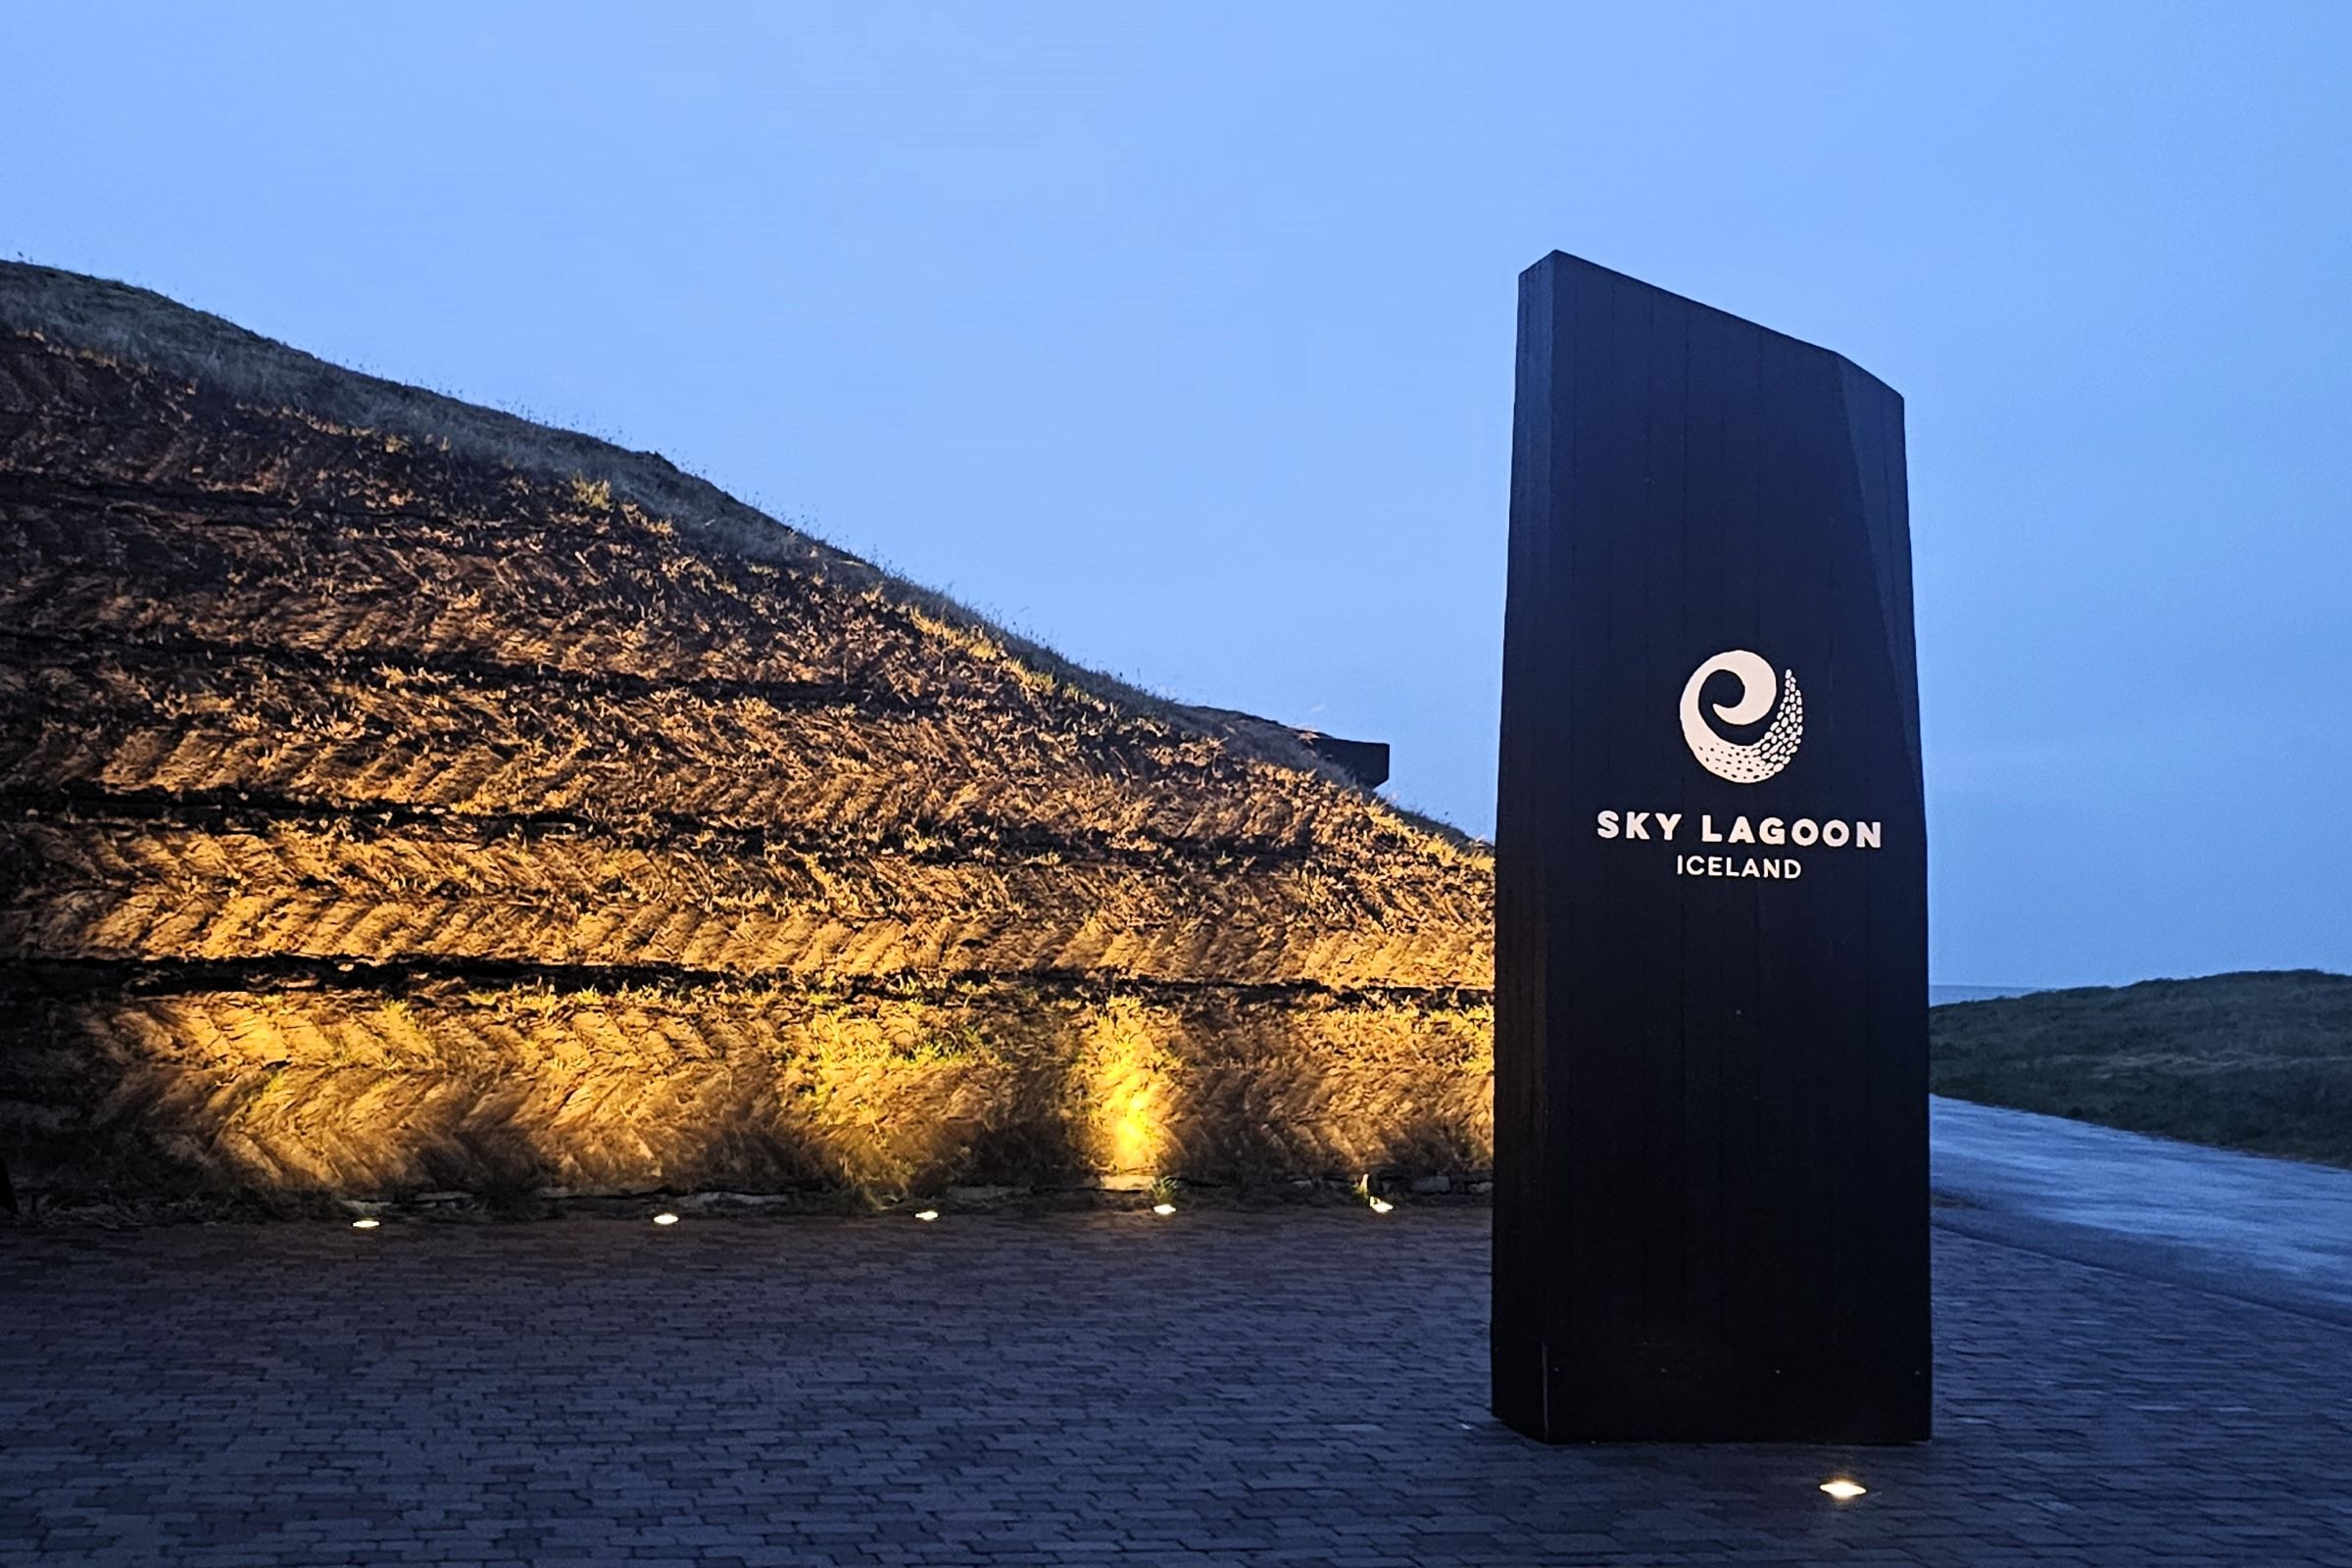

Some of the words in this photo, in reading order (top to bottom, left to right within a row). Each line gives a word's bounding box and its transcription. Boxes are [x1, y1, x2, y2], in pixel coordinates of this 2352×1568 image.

[1596, 809, 1683, 841] SKY
[1701, 814, 1882, 849] LAGOON
[1677, 855, 1802, 879] ICELAND
